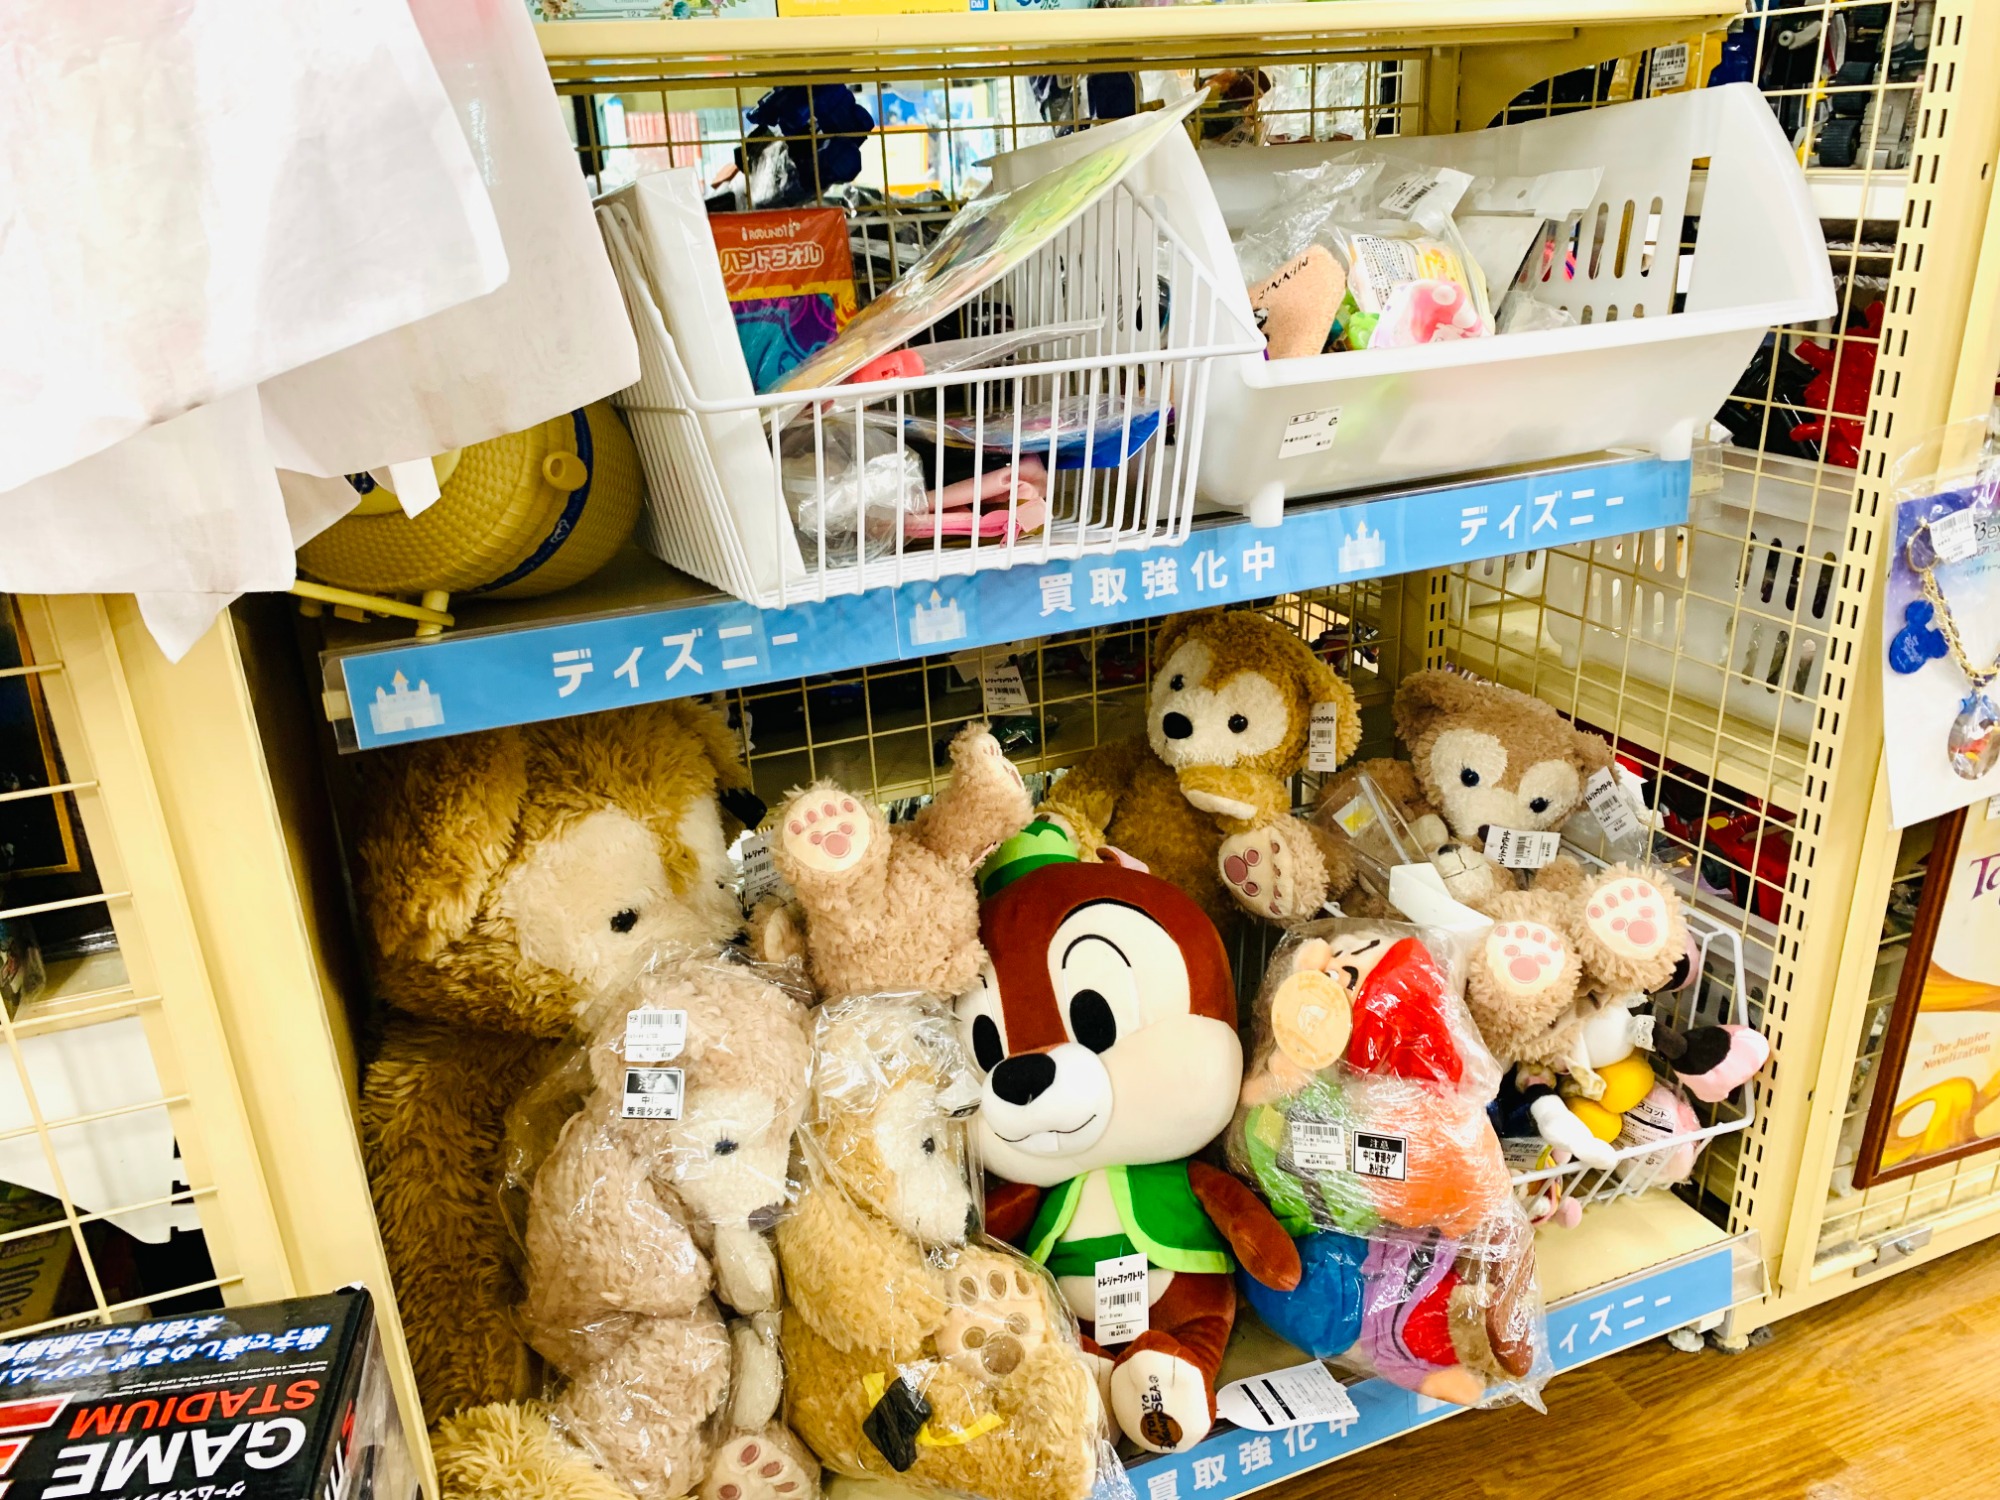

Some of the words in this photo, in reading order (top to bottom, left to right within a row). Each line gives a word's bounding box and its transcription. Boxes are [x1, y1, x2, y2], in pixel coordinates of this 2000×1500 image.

[722, 244, 821, 272] ハンドタオル
[1461, 489, 1624, 547] ディズニー
[1038, 541, 1275, 617] 買取強化中
[553, 625, 798, 698] ディズニー
[1097, 1270, 1146, 1288] トレジャーファクトリー
[67, 1380, 321, 1440] STADIUM
[41, 1416, 307, 1500] GAME
